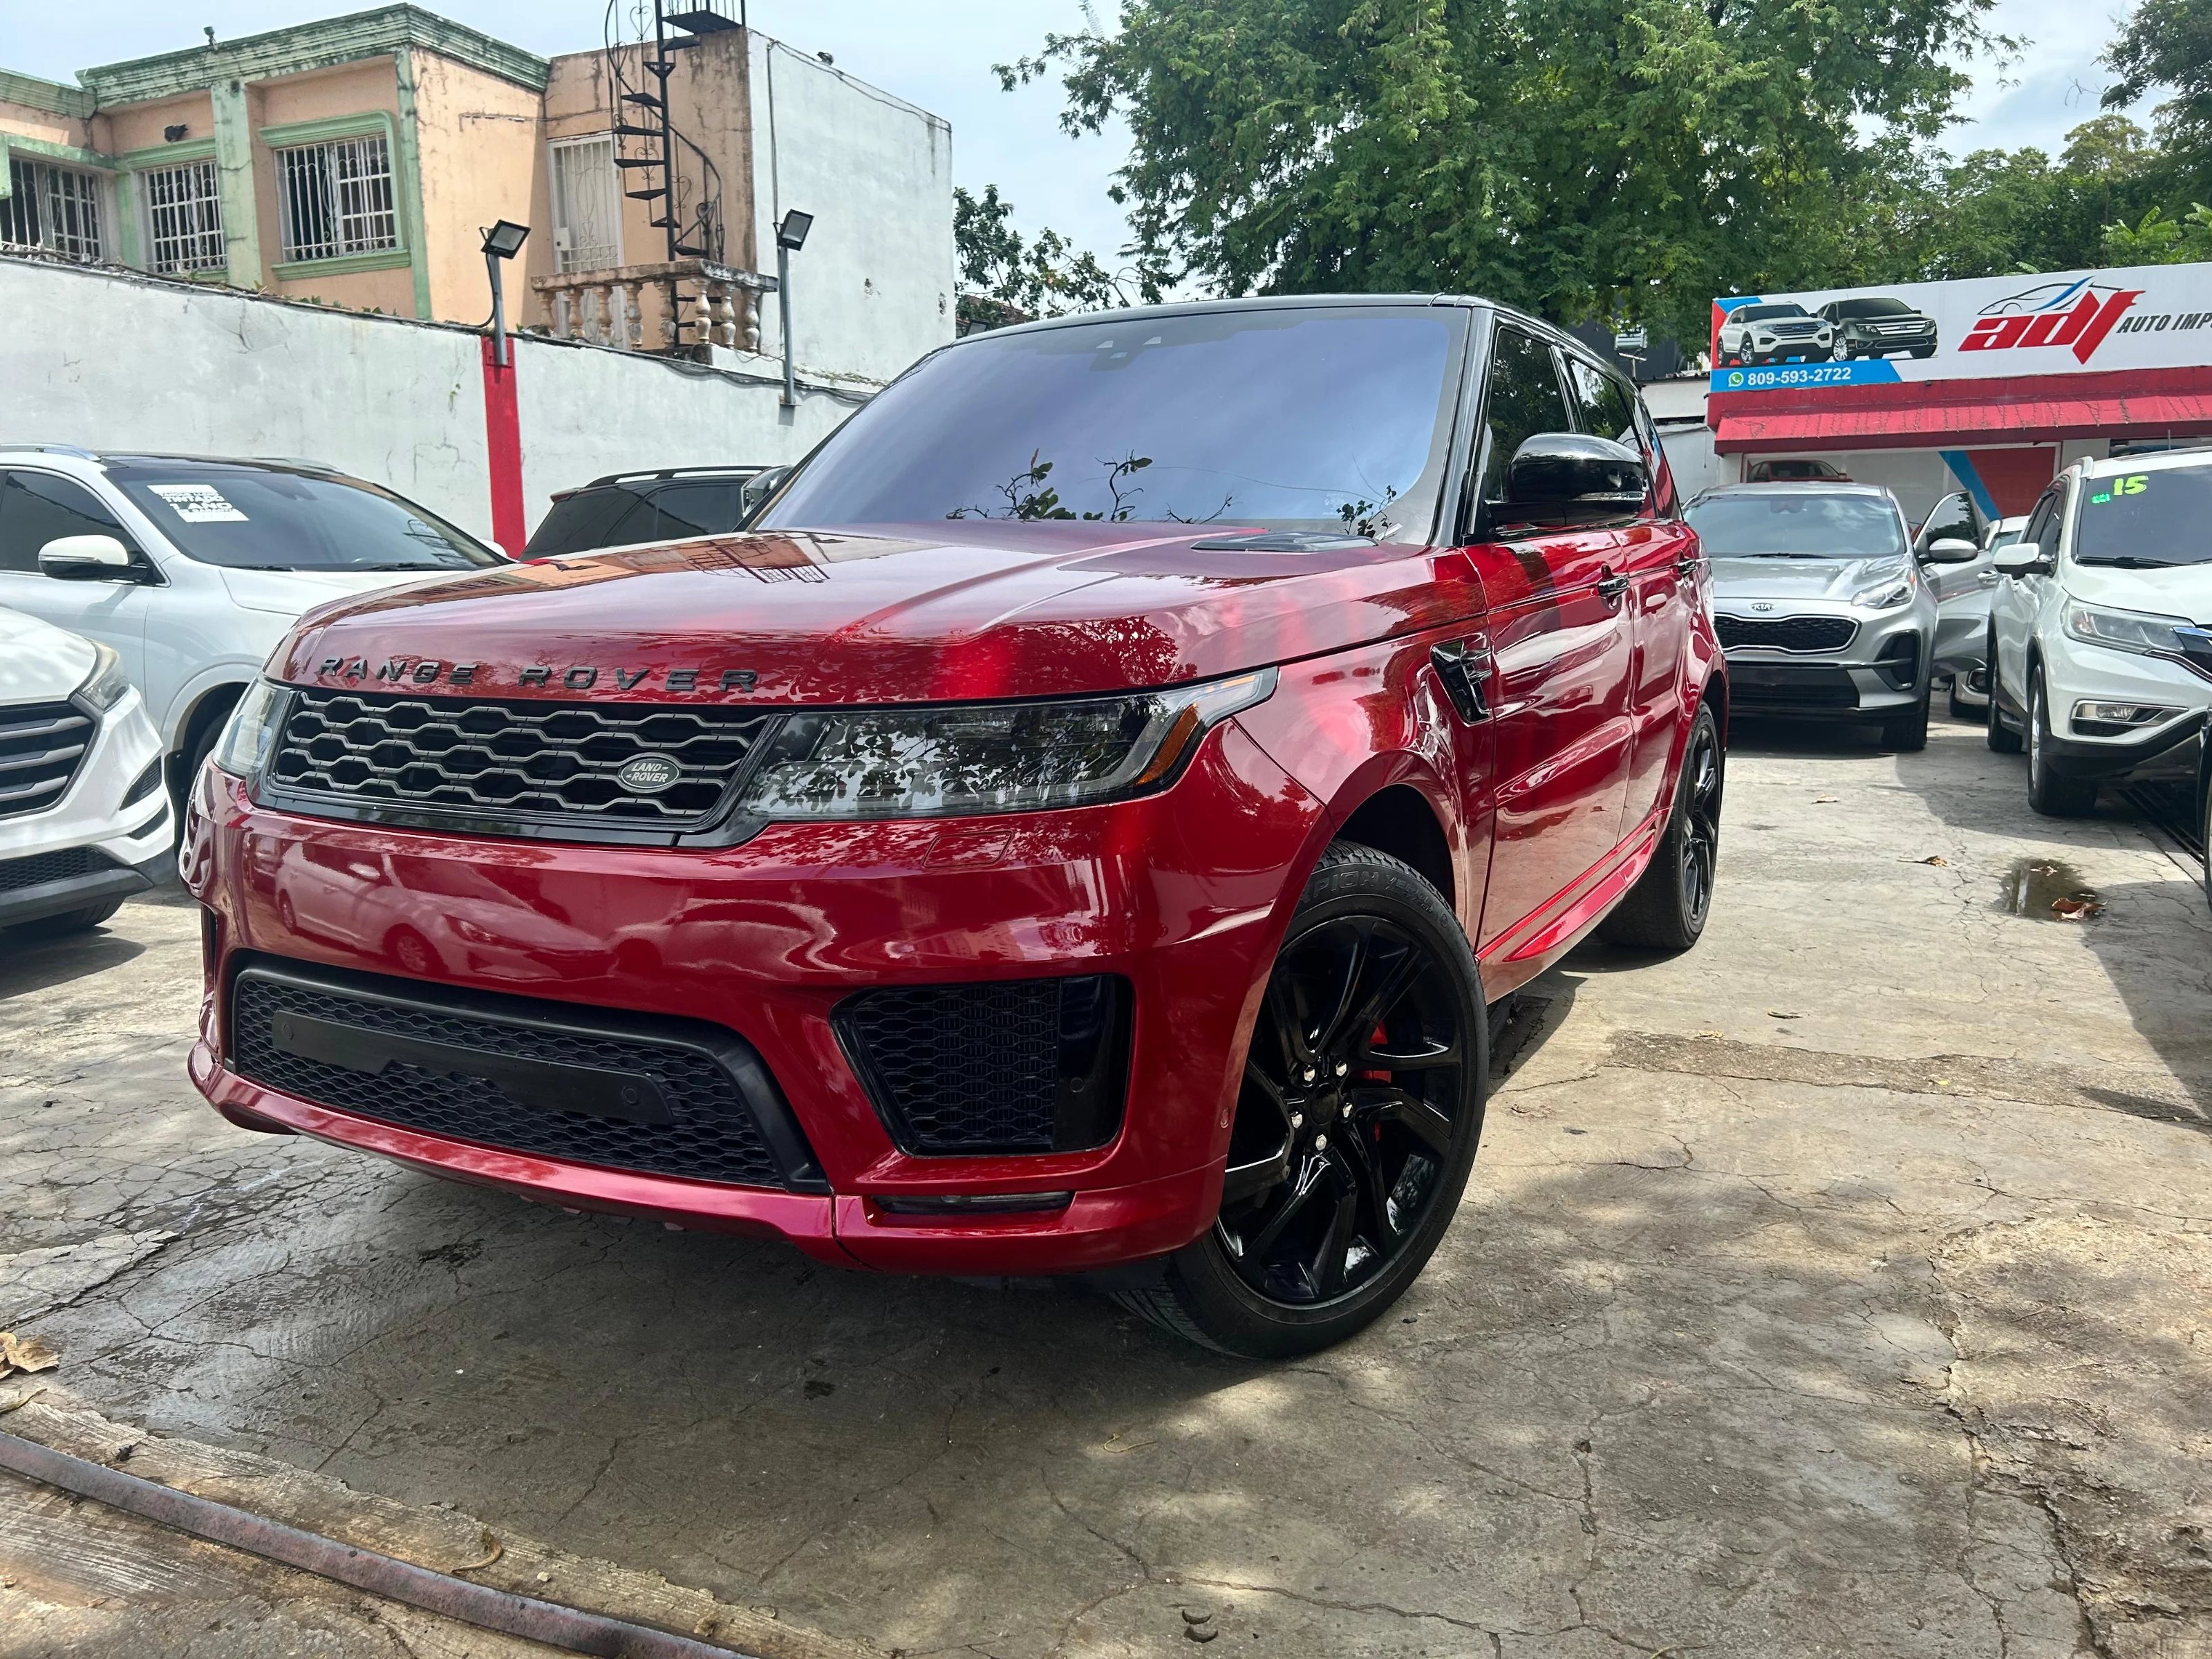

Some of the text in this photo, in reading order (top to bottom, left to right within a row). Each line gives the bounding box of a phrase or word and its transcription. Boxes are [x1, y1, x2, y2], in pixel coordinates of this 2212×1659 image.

[2116, 312, 2212, 333] AUTO IMP
[1747, 366, 1852, 386] 809-593-2722
[2113, 475, 2149, 495] 15
[319, 656, 758, 693] RANGE ROVER
